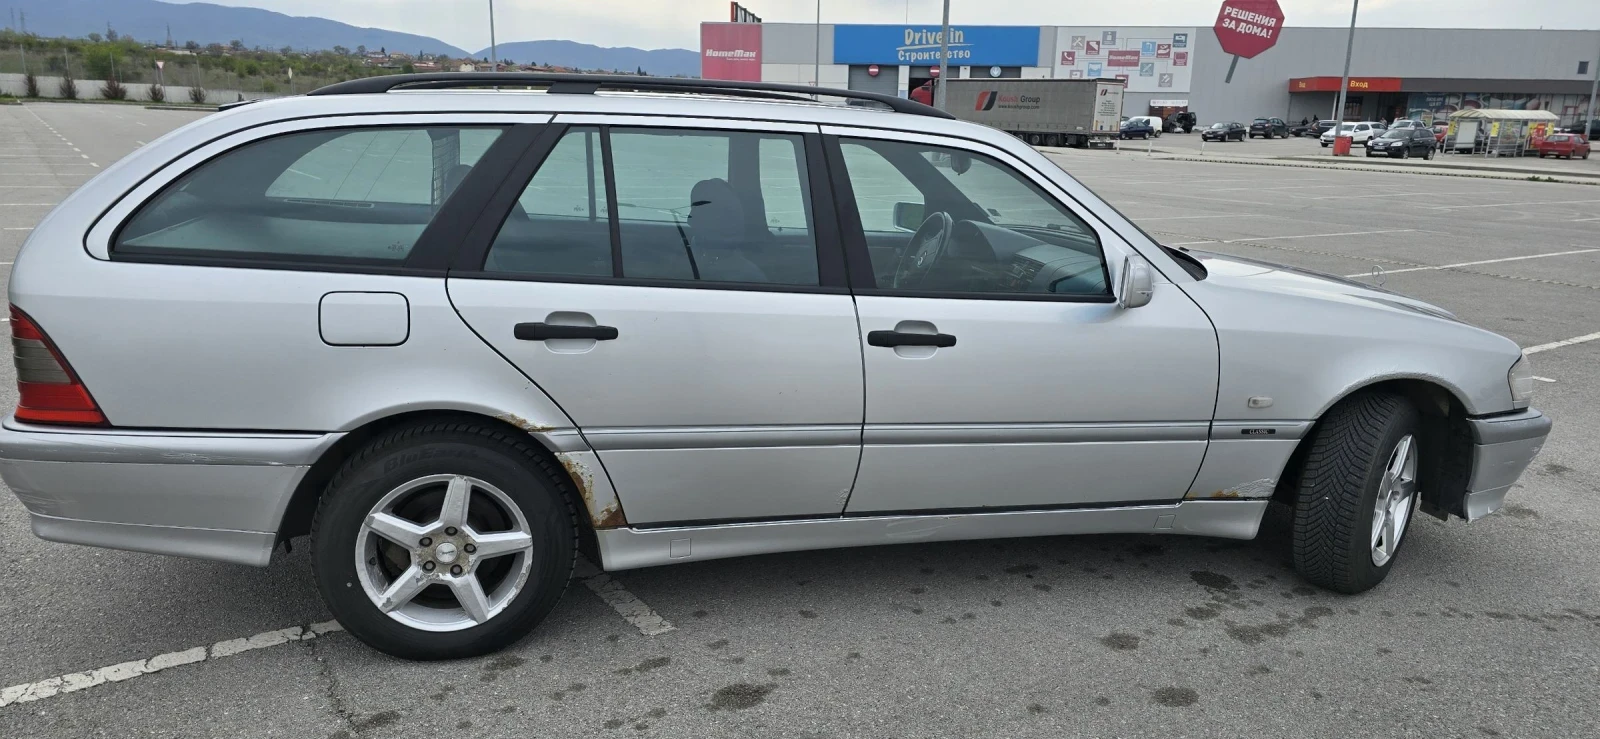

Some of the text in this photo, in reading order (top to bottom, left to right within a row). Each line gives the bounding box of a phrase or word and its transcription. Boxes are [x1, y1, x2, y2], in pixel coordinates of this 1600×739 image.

[1224, 6, 1276, 27] РЕШЕНИЯ
[1222, 18, 1272, 38] ЗА ДОМА!
[705, 48, 756, 58] HomeMax
[898, 49, 971, 63] Строитество
[1350, 80, 1368, 88] Вход
[1020, 95, 1041, 104] Group
